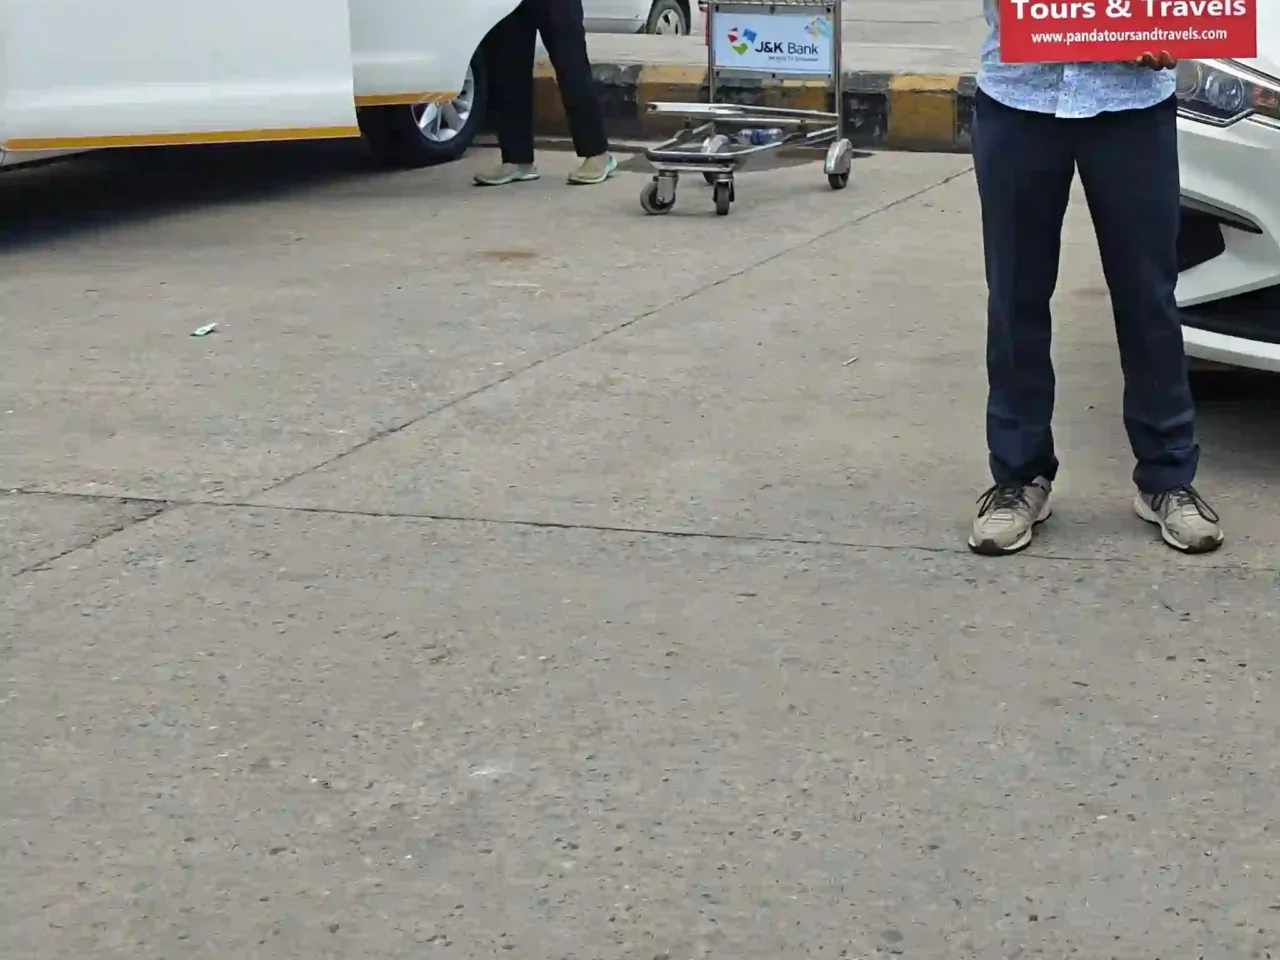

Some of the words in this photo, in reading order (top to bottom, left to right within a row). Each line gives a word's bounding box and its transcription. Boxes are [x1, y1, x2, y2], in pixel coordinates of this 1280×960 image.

[1031, 26, 1228, 46] www.pandatoursandtravels.com
[754, 41, 784, 54] J&K
[787, 42, 819, 55] Bank
